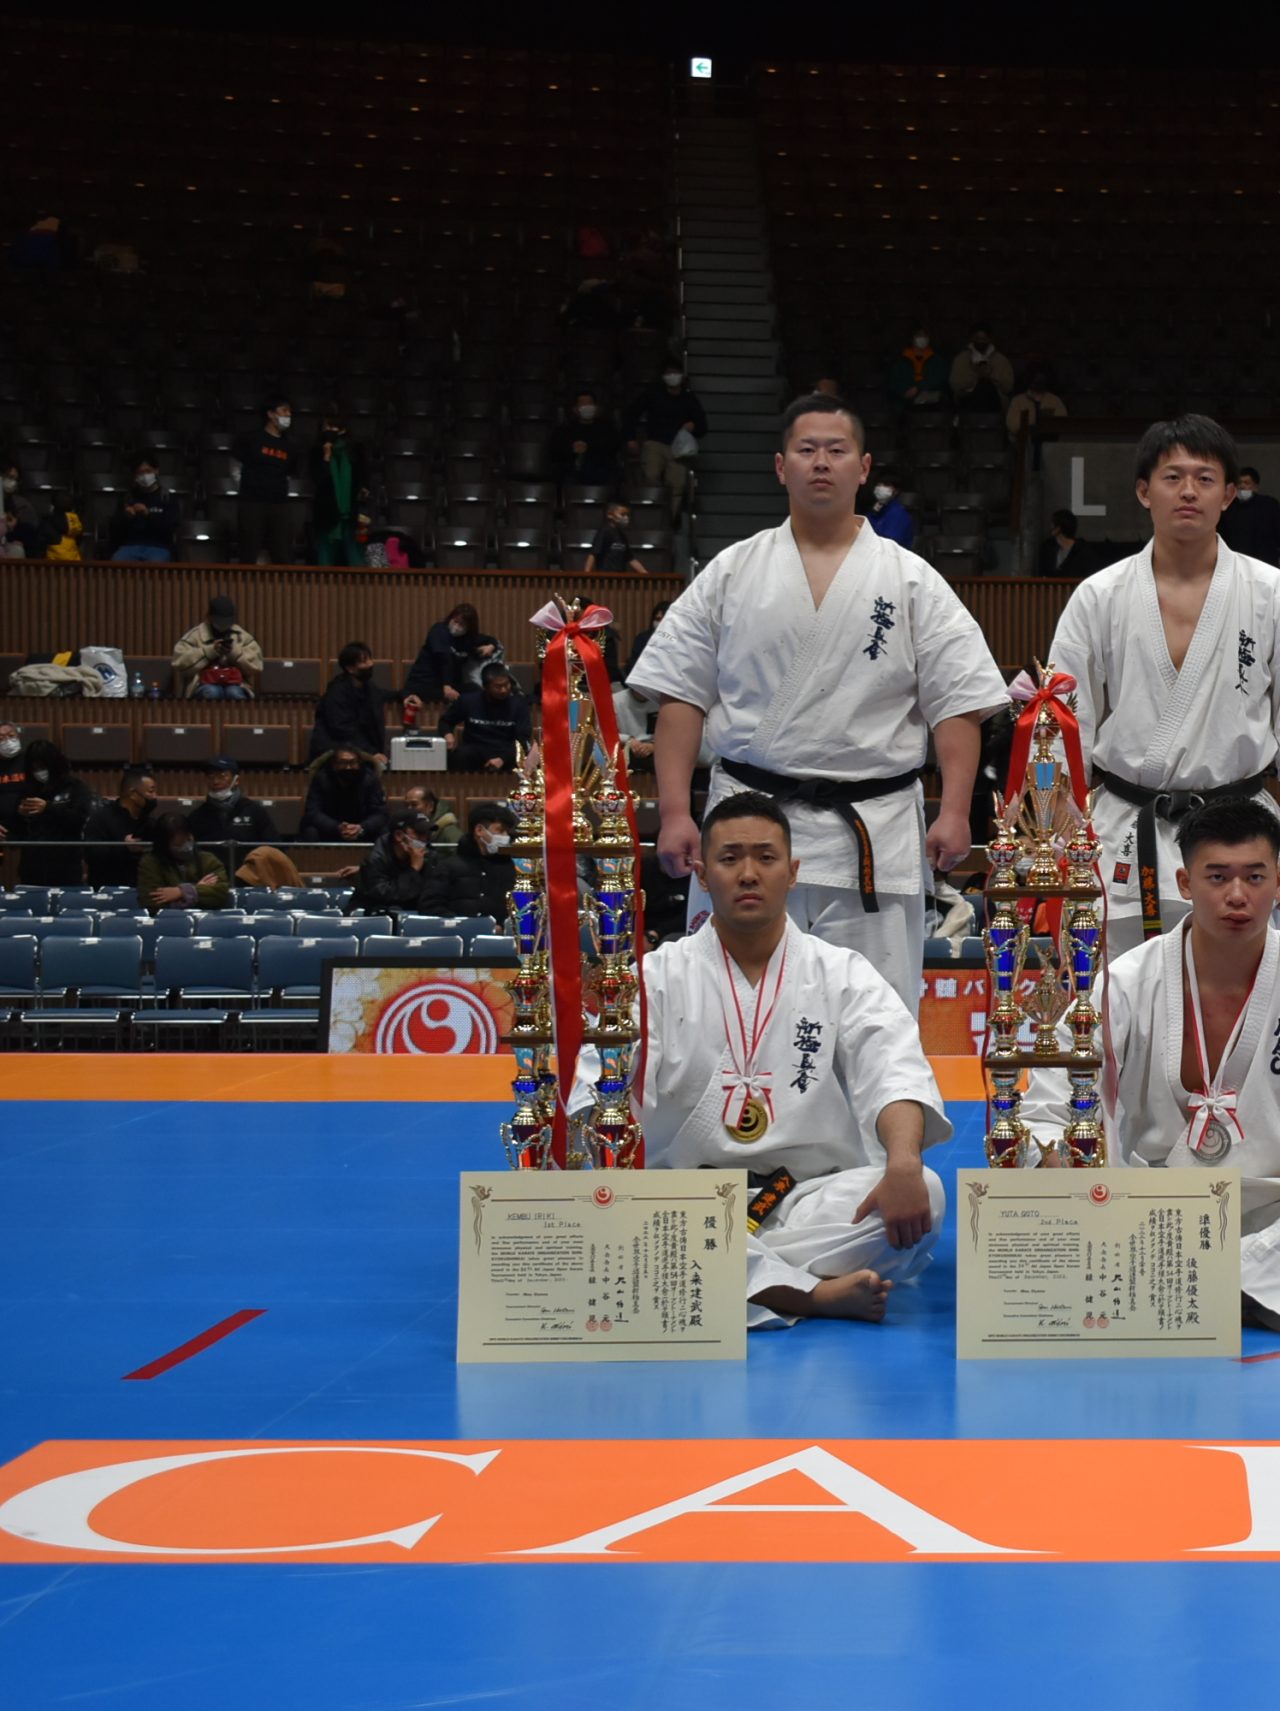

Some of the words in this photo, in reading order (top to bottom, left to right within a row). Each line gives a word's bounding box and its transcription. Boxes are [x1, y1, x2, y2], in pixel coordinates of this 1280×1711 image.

[1071, 456, 1107, 517] L
[703, 1215, 718, 1251] 優勝
[1199, 1213, 1212, 1251] 準優勝
